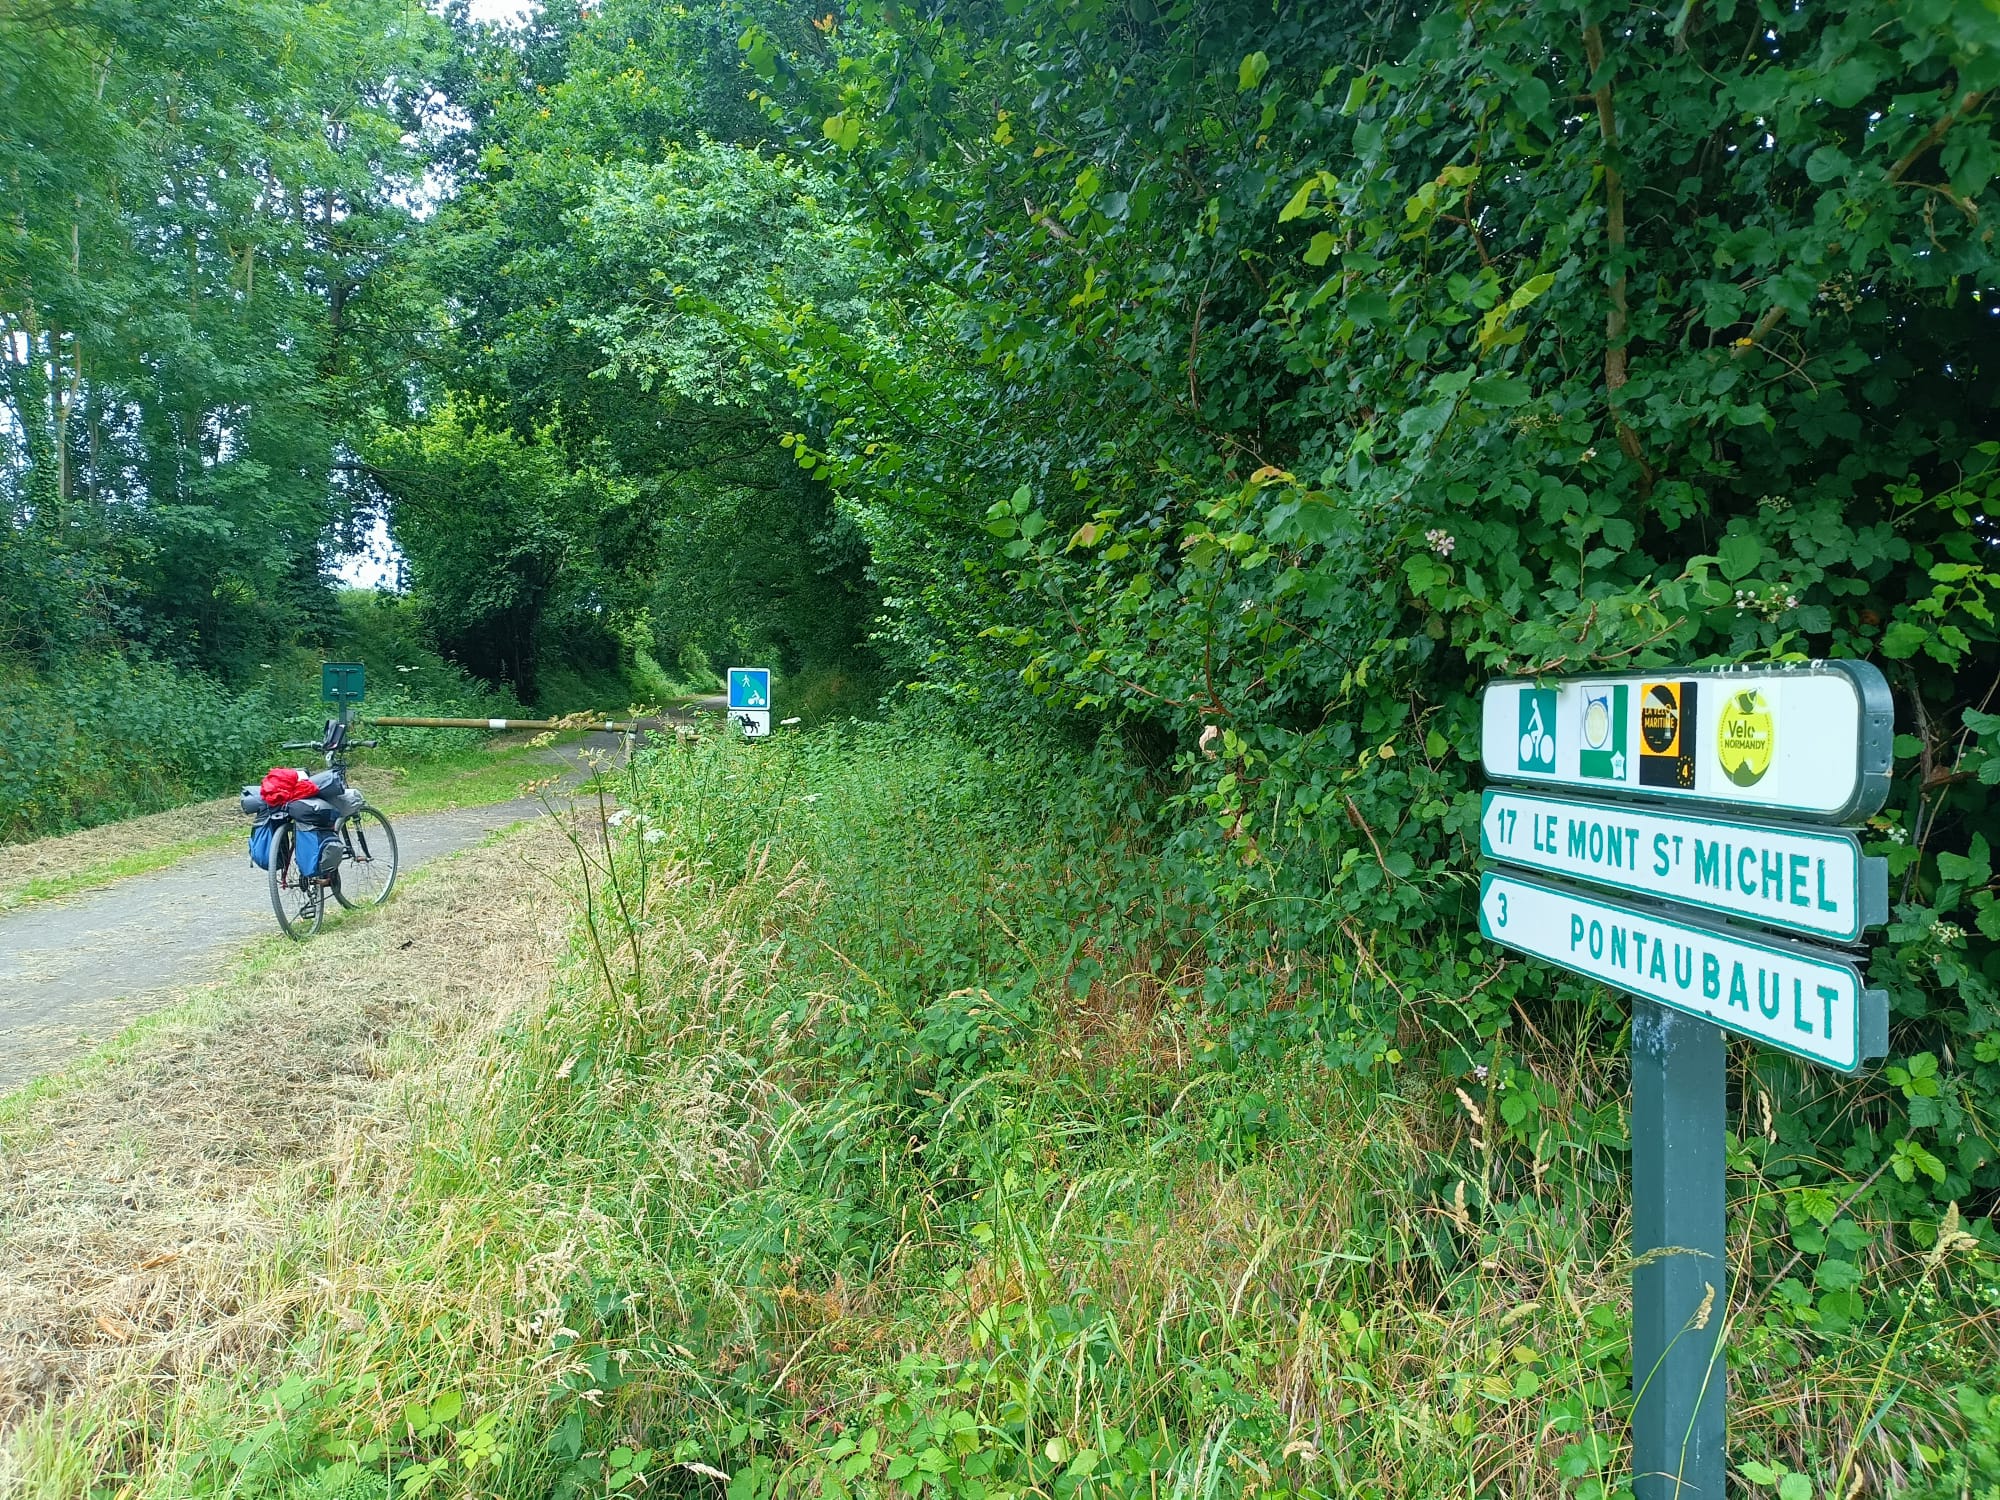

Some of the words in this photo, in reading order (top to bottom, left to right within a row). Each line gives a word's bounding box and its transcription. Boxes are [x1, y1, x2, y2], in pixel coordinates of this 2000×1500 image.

[1644, 717, 1675, 729] MARITIME
[1724, 739, 1766, 750] NORMANDY
[1682, 764, 1689, 778] 4
[1498, 808, 1517, 844] 17
[1534, 813, 1557, 854] LE
[1568, 819, 1639, 871] MONT
[1694, 838, 1837, 912] MICHEL
[1497, 892, 1507, 928] 3
[1571, 913, 1838, 1040] PONTAUBAULT
